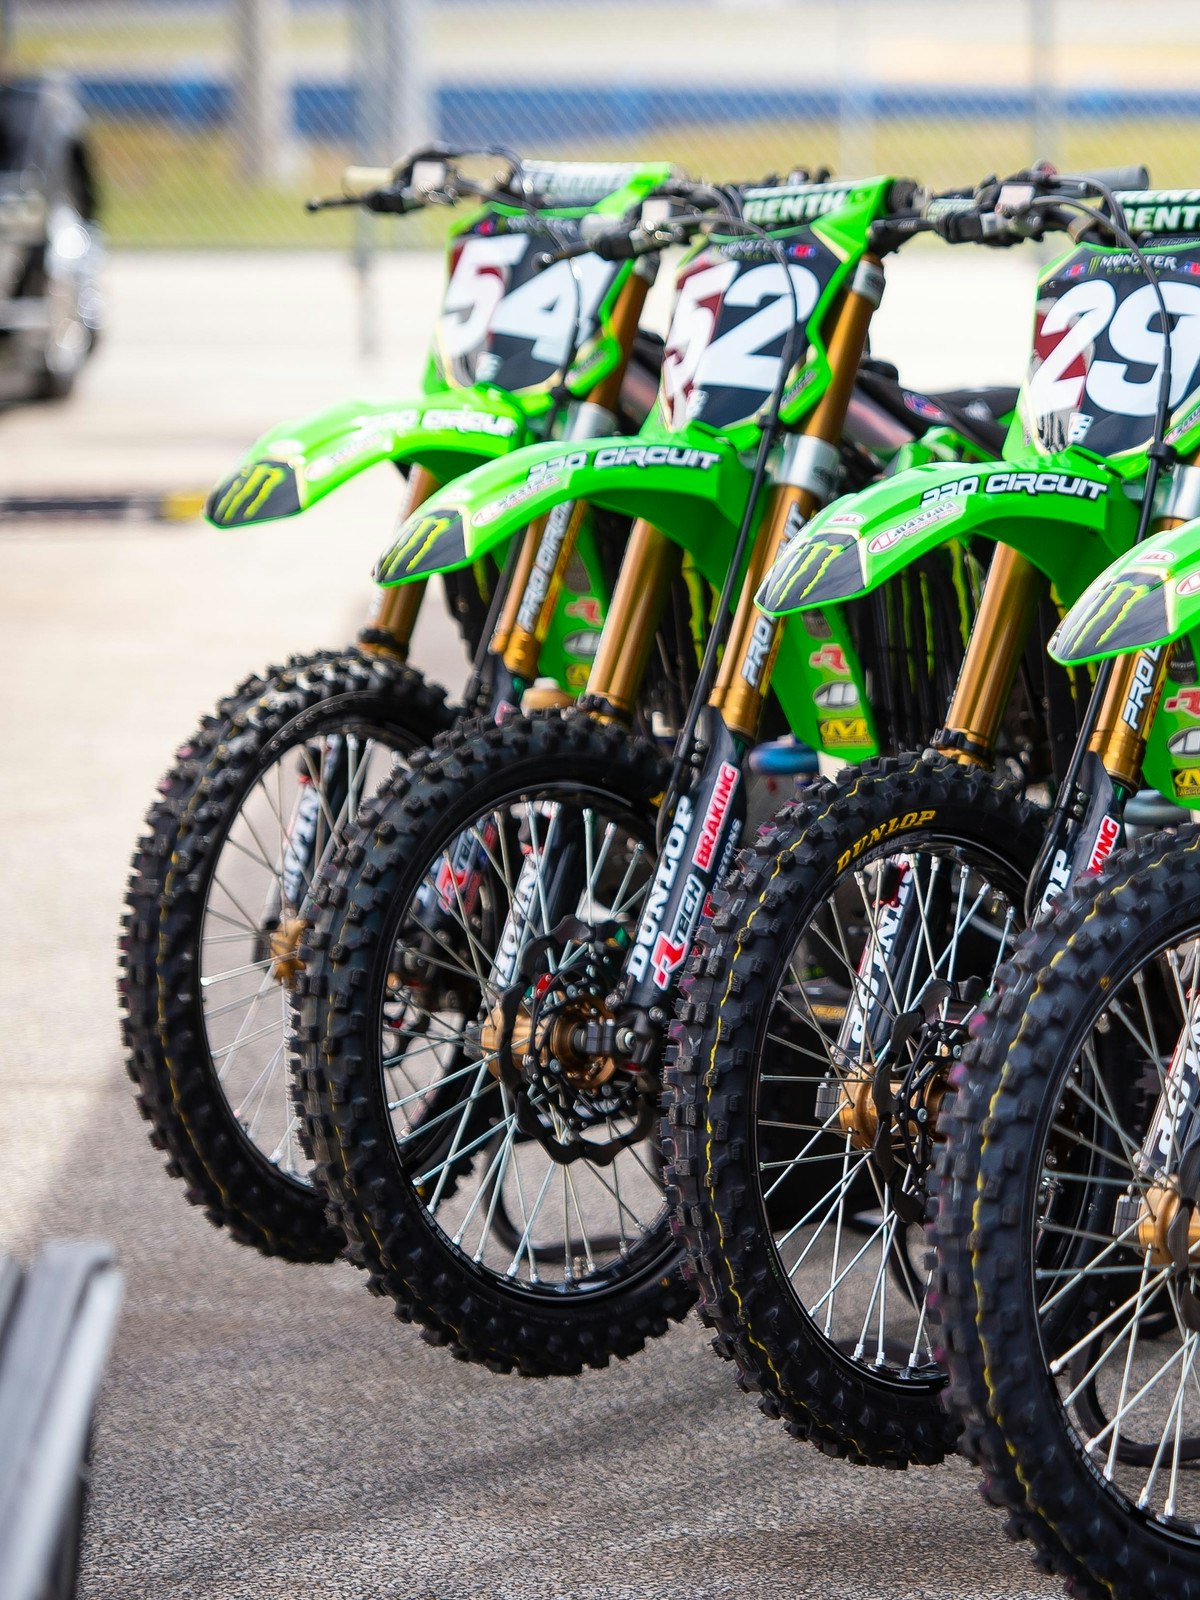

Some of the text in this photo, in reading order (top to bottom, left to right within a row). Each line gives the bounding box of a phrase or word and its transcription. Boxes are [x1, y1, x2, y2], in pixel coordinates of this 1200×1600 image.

[742, 191, 851, 224] RENTH
[439, 233, 616, 366] 54
[664, 261, 821, 402] 52
[594, 446, 721, 471] CIRCUIT
[986, 473, 1107, 499] CIRCUIT
[741, 616, 776, 688] PRO
[1122, 654, 1155, 730] PRO
[693, 762, 739, 873] BRAKING
[836, 810, 936, 875] DUNLOP
[1087, 818, 1121, 874] KING
[626, 795, 693, 983] DUNLOP
